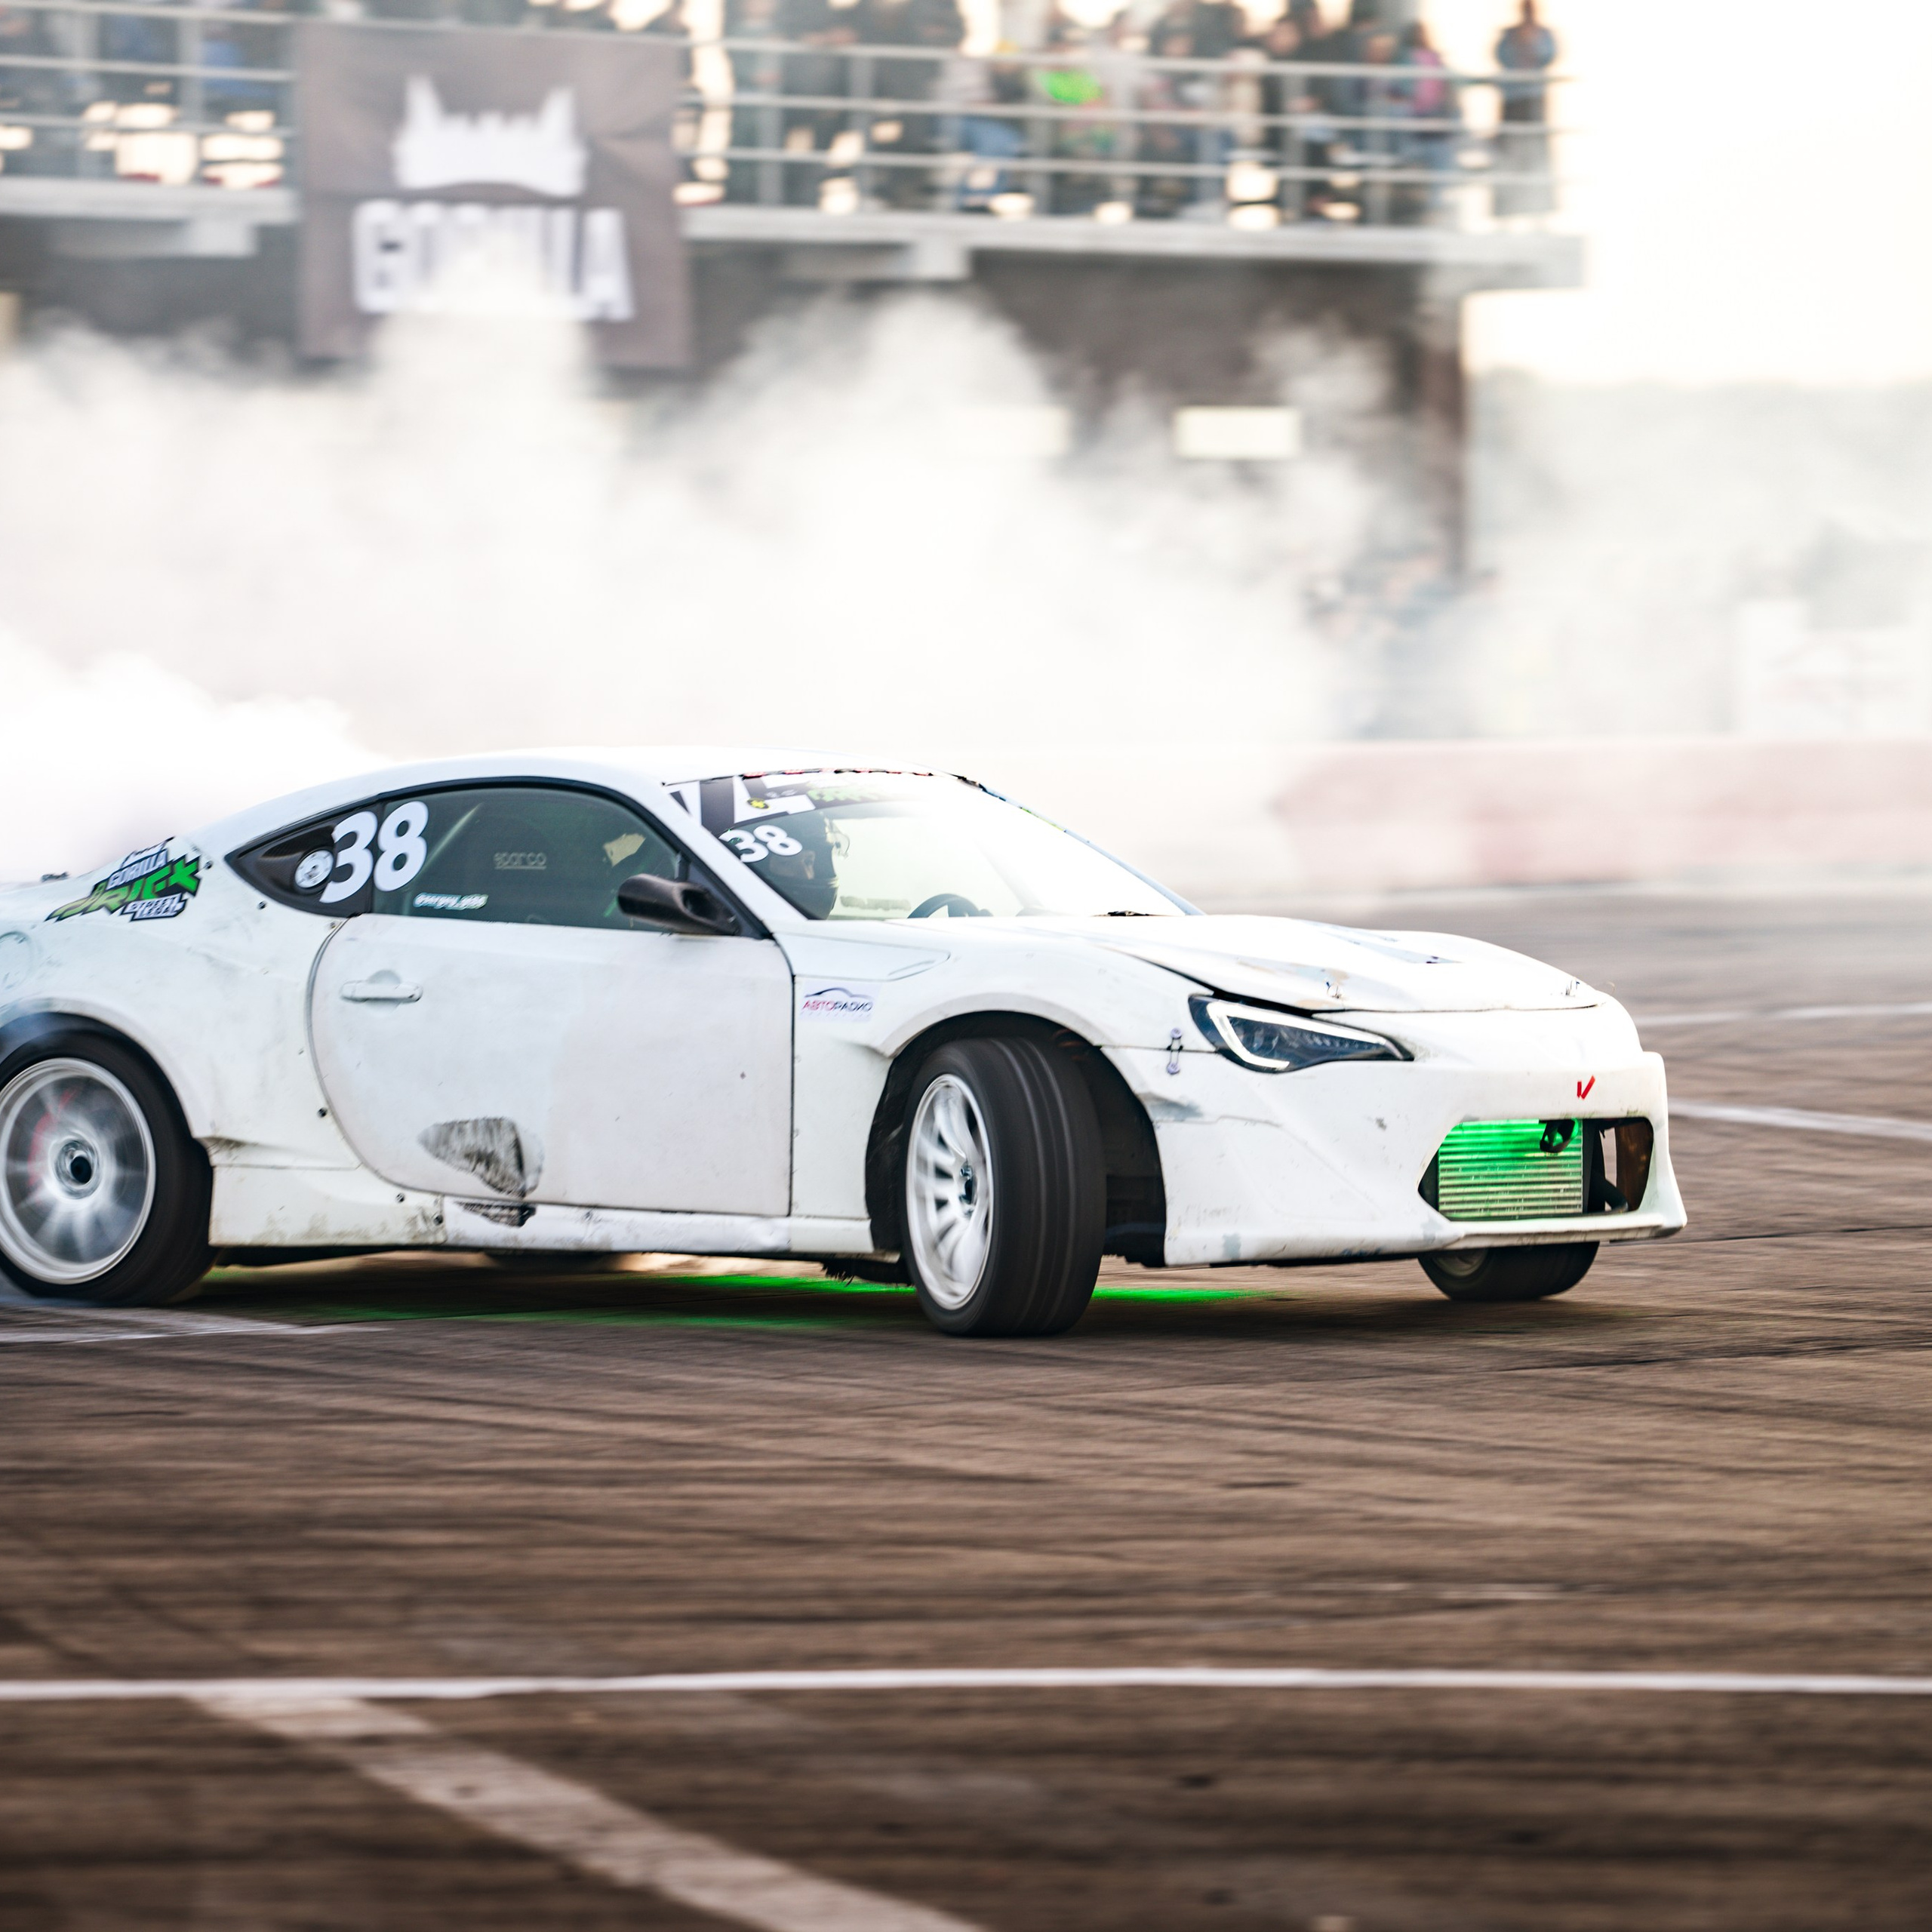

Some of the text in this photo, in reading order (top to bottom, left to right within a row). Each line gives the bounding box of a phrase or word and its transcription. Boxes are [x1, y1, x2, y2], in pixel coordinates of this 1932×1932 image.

[352, 200, 635, 321] GOLLA
[319, 801, 429, 903] 38
[718, 825, 802, 863] 38
[494, 852, 546, 870] sparco
[123, 894, 182, 914] STREET
[133, 905, 186, 919] LEGAL
